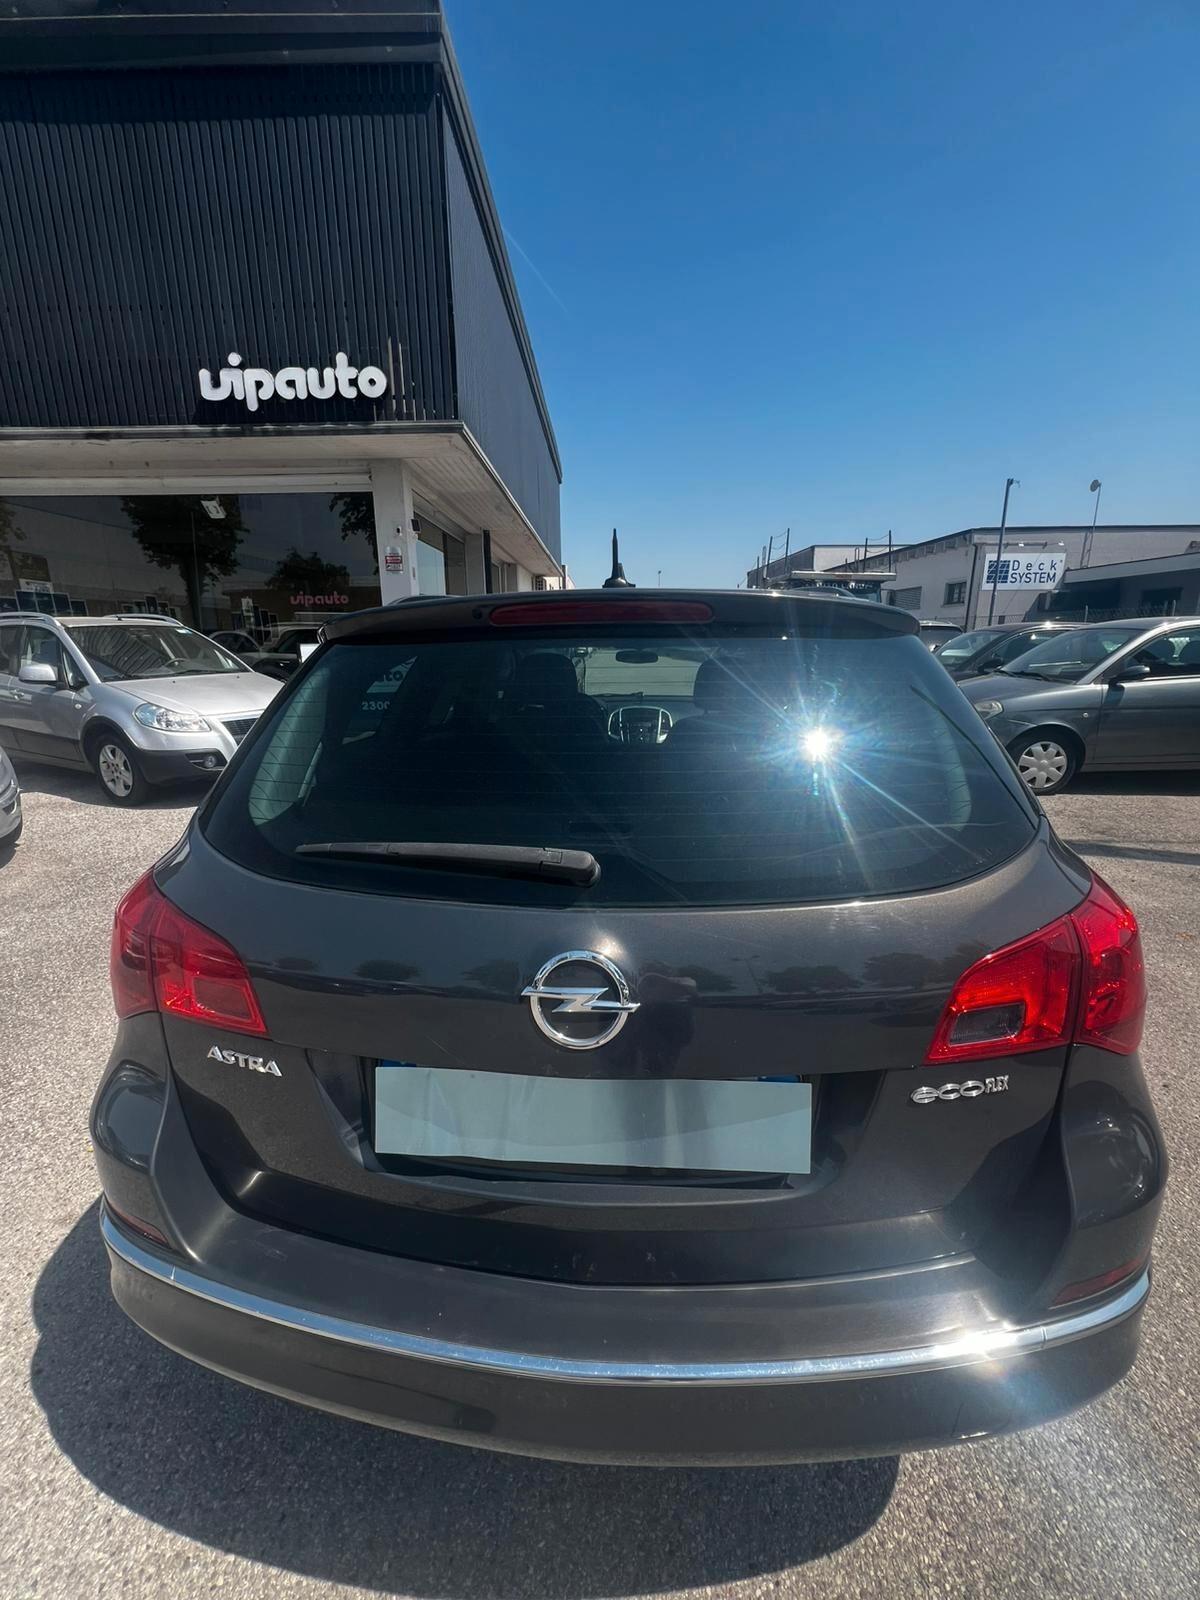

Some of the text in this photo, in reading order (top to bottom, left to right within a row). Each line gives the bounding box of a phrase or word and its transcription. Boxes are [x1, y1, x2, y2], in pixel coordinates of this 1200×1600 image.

[1012, 560, 1057, 571] Deck
[1009, 572, 1056, 584] SYSTEM
[207, 1045, 283, 1077] ASTRA
